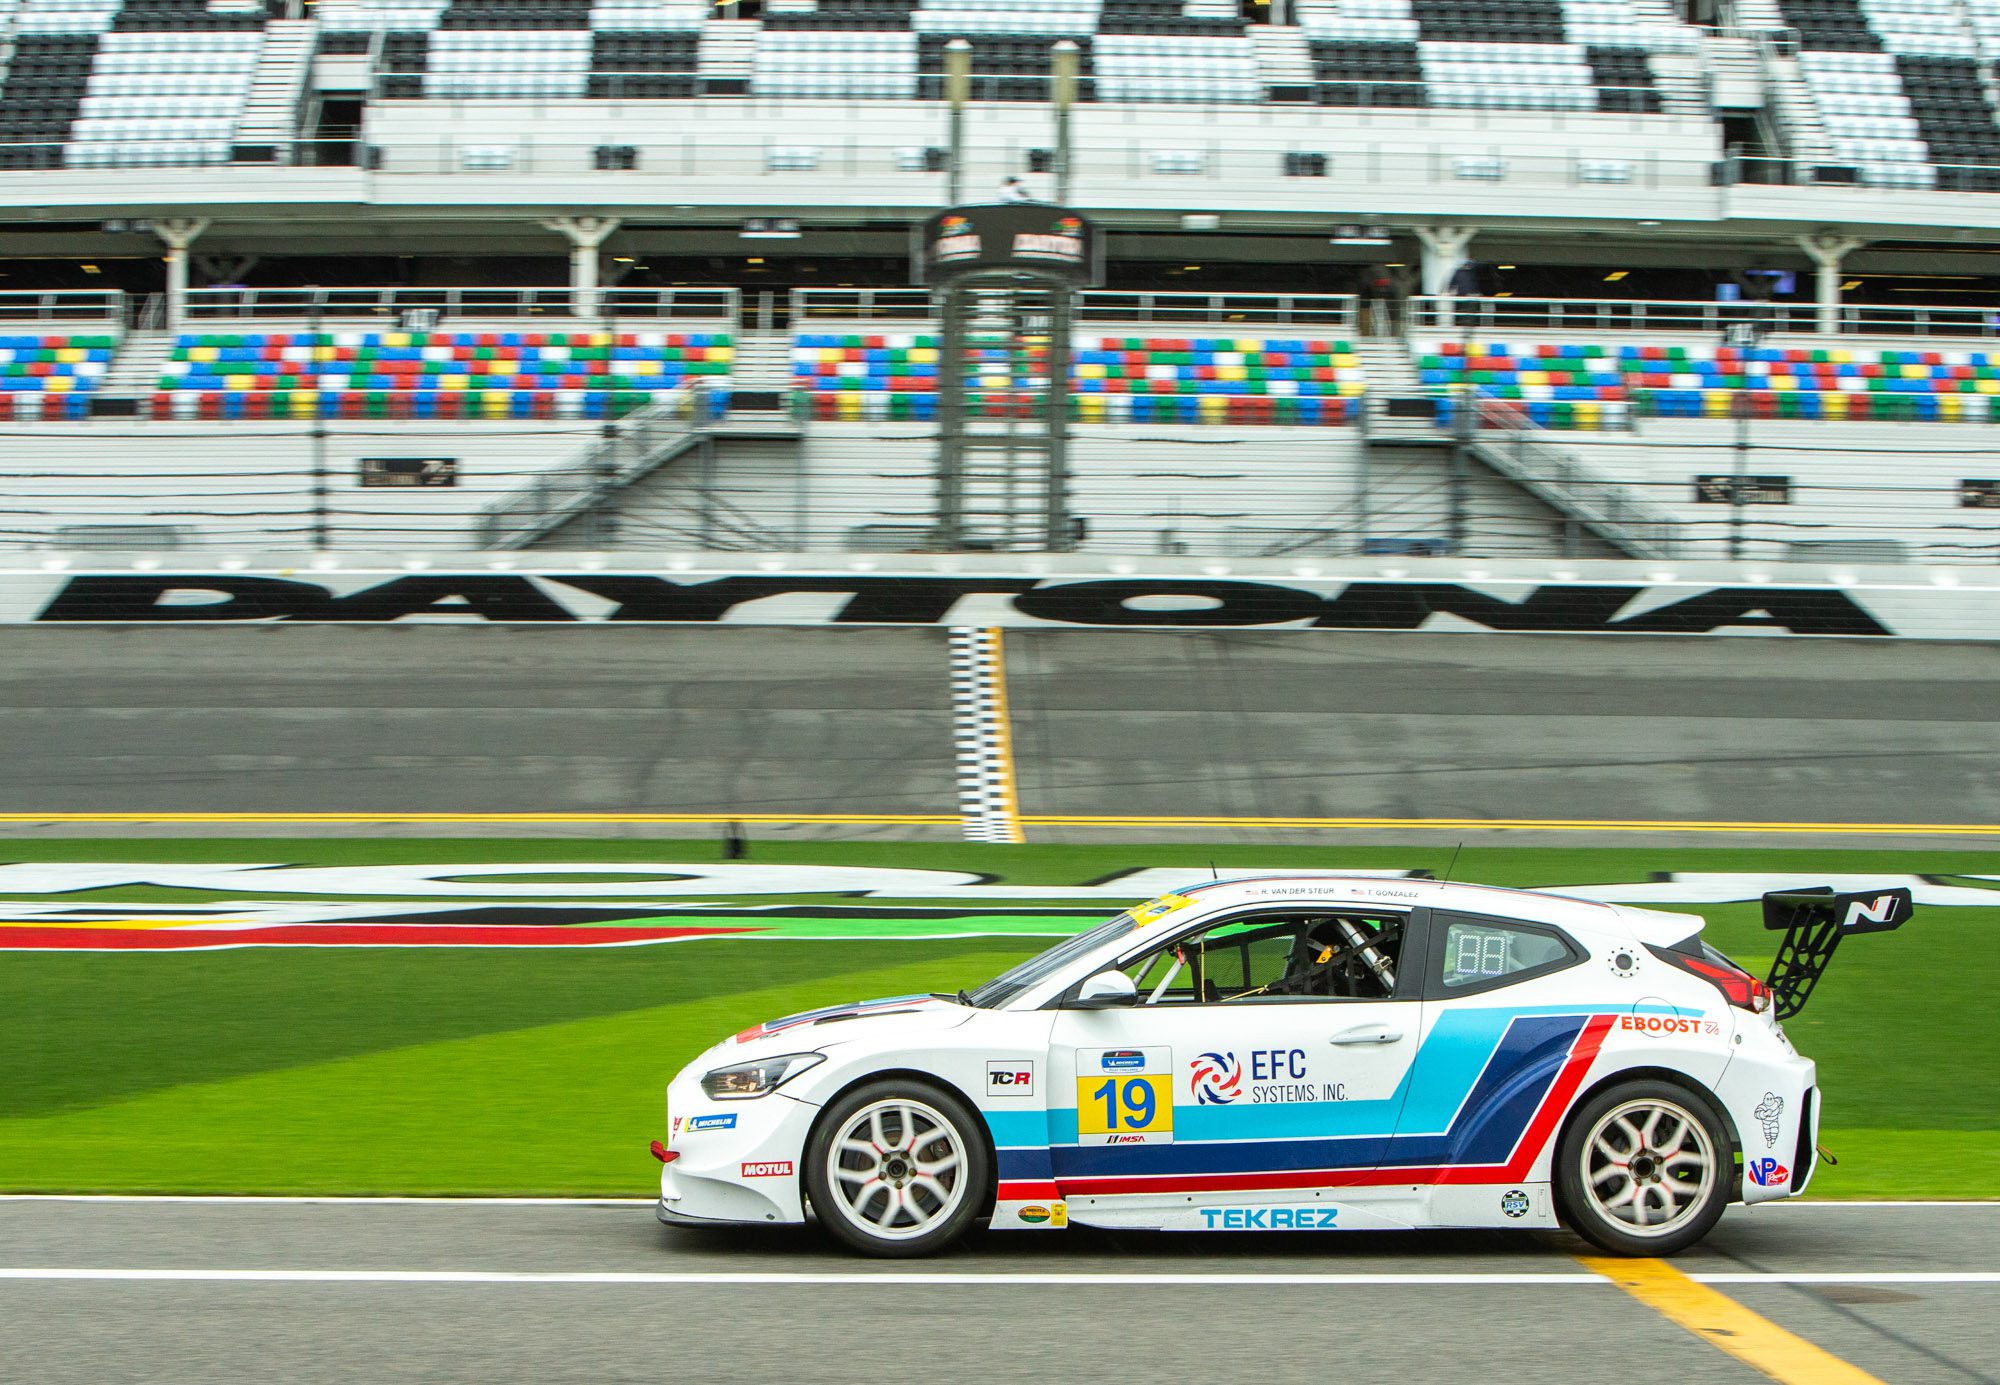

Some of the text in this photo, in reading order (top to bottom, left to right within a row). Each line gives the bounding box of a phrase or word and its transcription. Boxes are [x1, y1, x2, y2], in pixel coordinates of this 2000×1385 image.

[35, 574, 1896, 637] DAYTONA
[1375, 890, 1419, 898] GONZALEZ
[1621, 1016, 1701, 1033] EBOOST
[1252, 1048, 1306, 1080] EFC
[989, 1071, 1031, 1085] TCR
[1252, 1083, 1349, 1103] SYSTEMS, INC.
[1094, 1078, 1156, 1129] 19
[698, 1118, 732, 1127] MICHELIN
[743, 1163, 791, 1176] MOTUL
[1750, 1157, 1777, 1186] VP
[1506, 1201, 1525, 1209] RSV
[1200, 1208, 1338, 1229] TEKREZ
